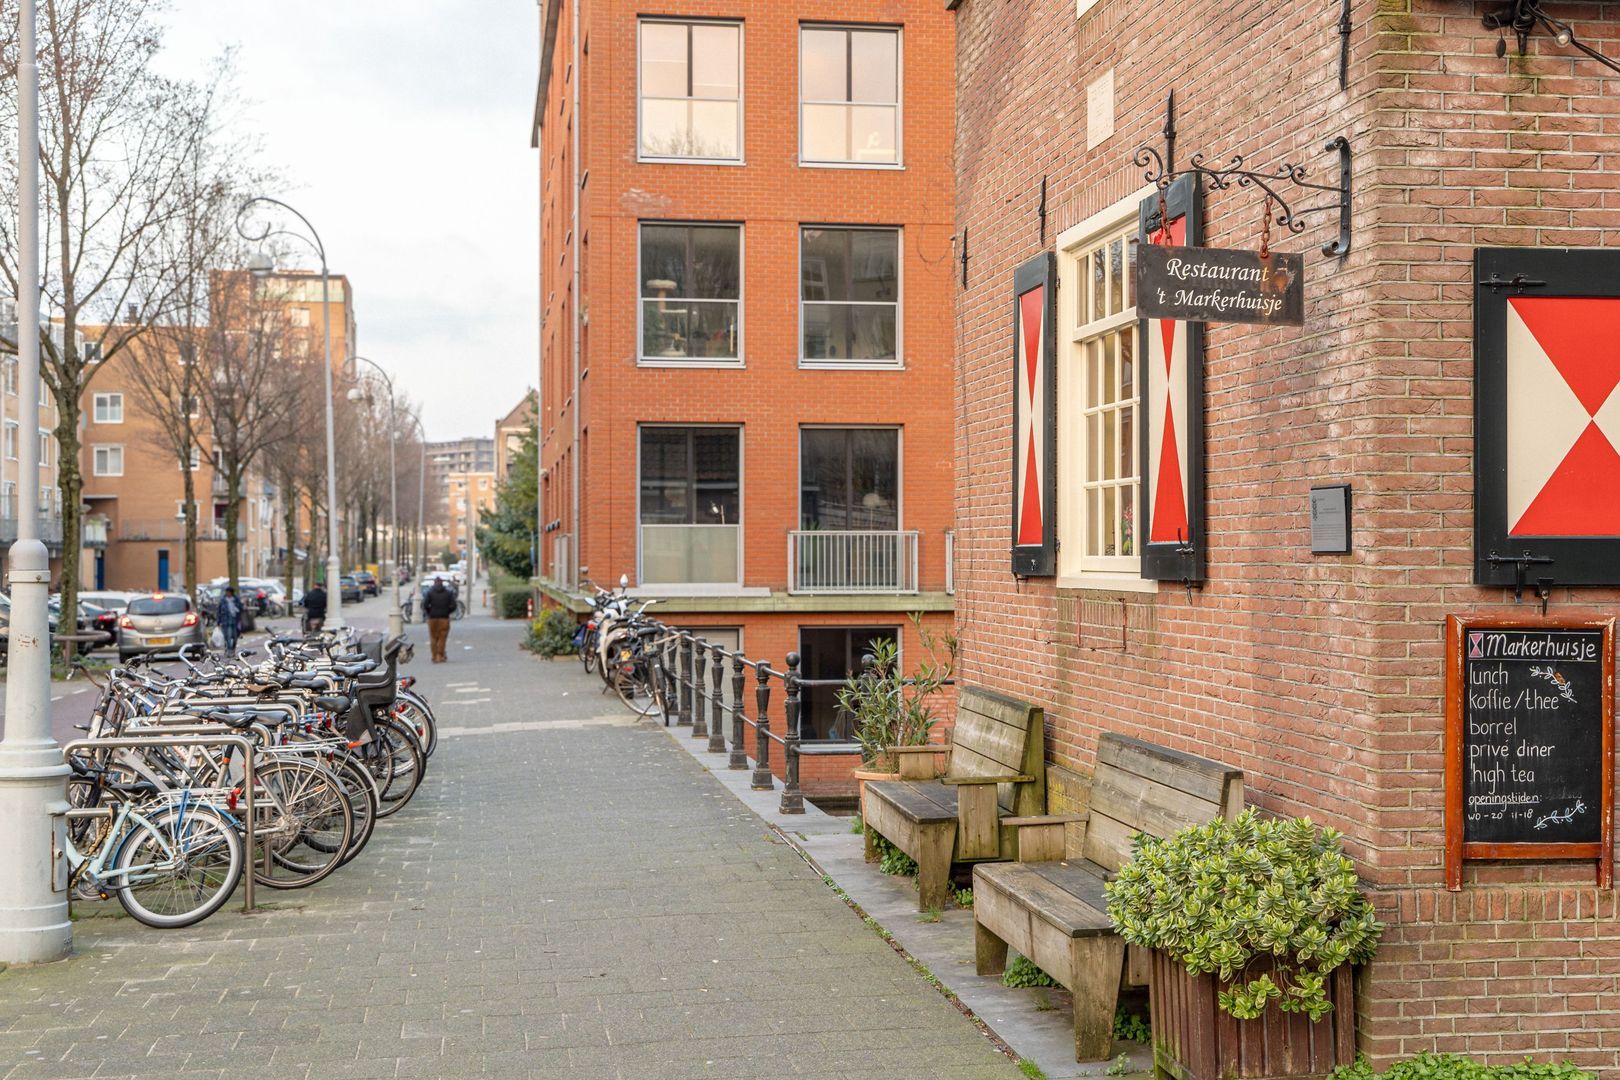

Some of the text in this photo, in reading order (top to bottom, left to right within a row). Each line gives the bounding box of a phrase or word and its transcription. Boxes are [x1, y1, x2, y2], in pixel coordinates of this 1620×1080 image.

[1166, 257, 1269, 283] Restaurant
[1174, 289, 1282, 316] Markerhuisje
[1486, 633, 1597, 661] Markerhuisje
[1469, 662, 1509, 685] lunch
[1469, 713, 1517, 735] borrel
[1469, 738, 1556, 770] privé diner
[1472, 761, 1535, 795] high tea
